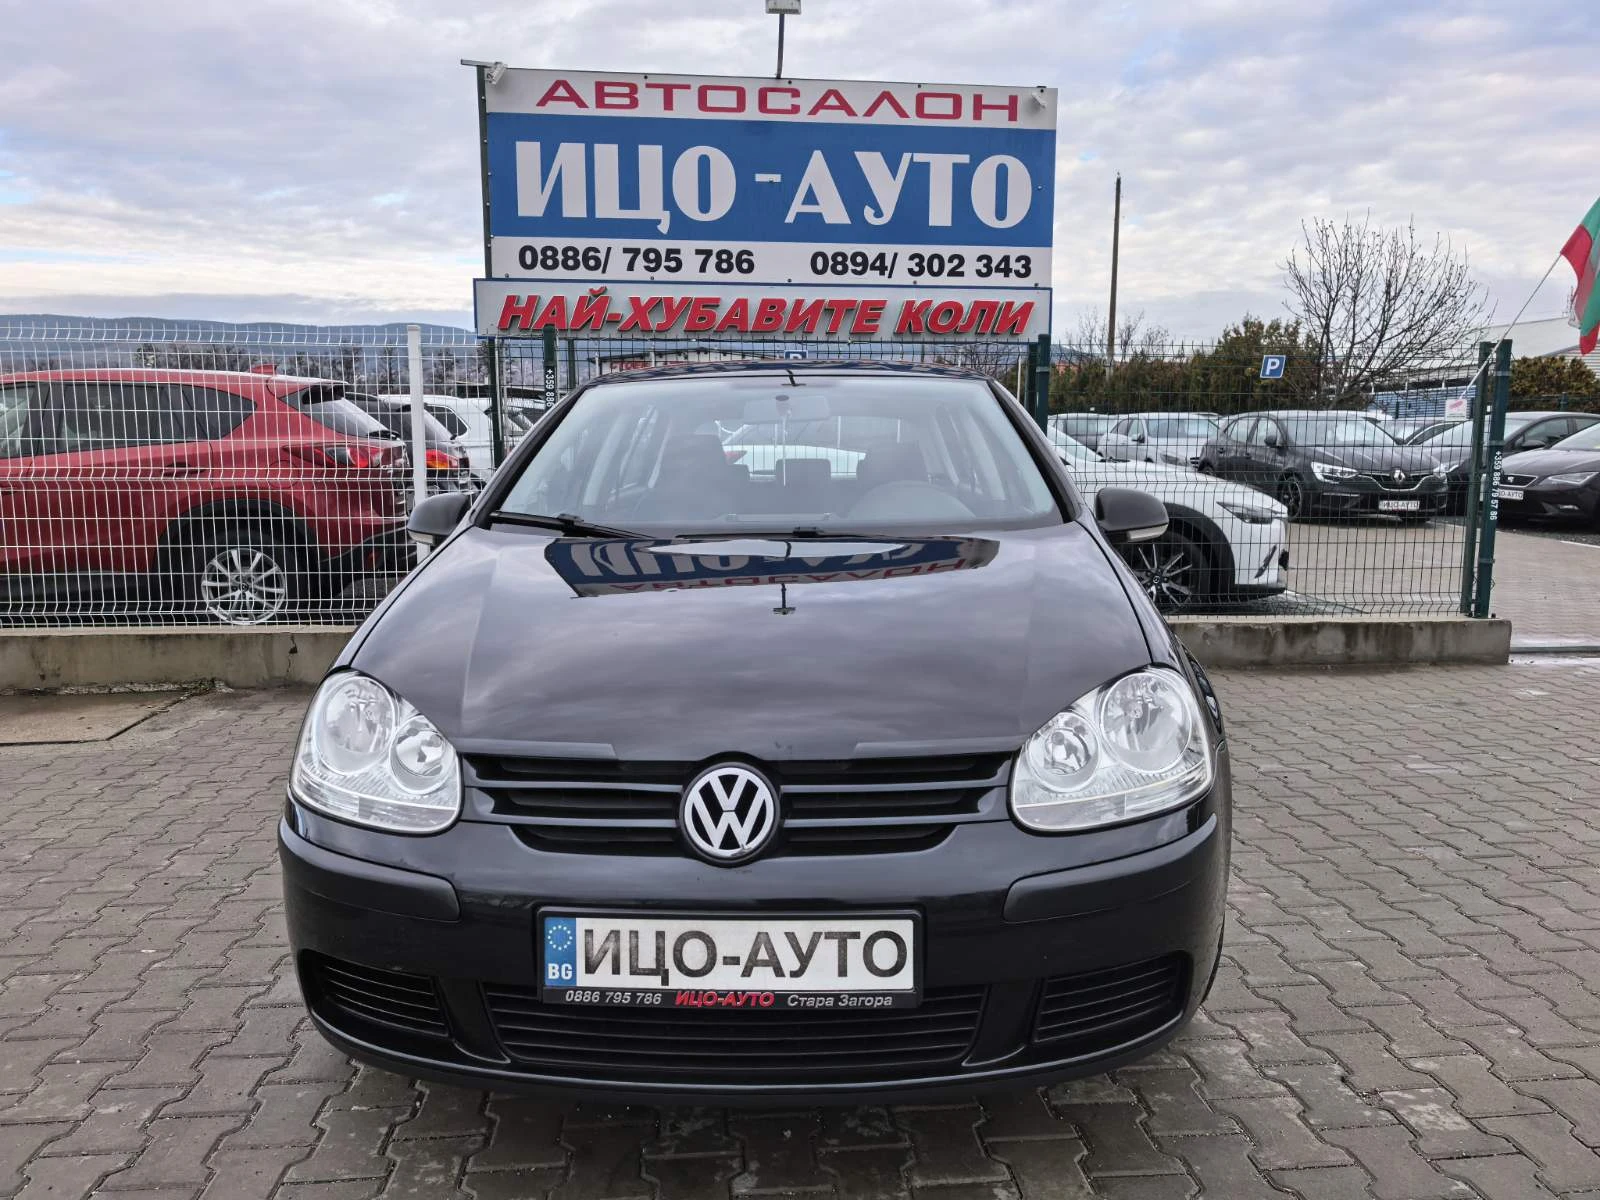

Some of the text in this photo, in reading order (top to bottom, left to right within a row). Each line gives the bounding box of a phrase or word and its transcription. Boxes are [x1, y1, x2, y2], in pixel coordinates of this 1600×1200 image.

[536, 79, 1018, 122] АВТОСАЛОН
[518, 245, 755, 275] 0886/ 795 786
[810, 251, 1033, 279] 0894/ 302 343
[498, 286, 1035, 335] НАЙ-ХУБАВИТЕ КОЛИ
[1490, 499, 1499, 509] 57
[582, 929, 908, 987] ИЦО-АУТО
[547, 963, 573, 980] BG
[565, 990, 663, 1005] 0886 795 786
[674, 991, 776, 1009] ИЦО-АУТО
[787, 994, 893, 1008] Стара Загора
